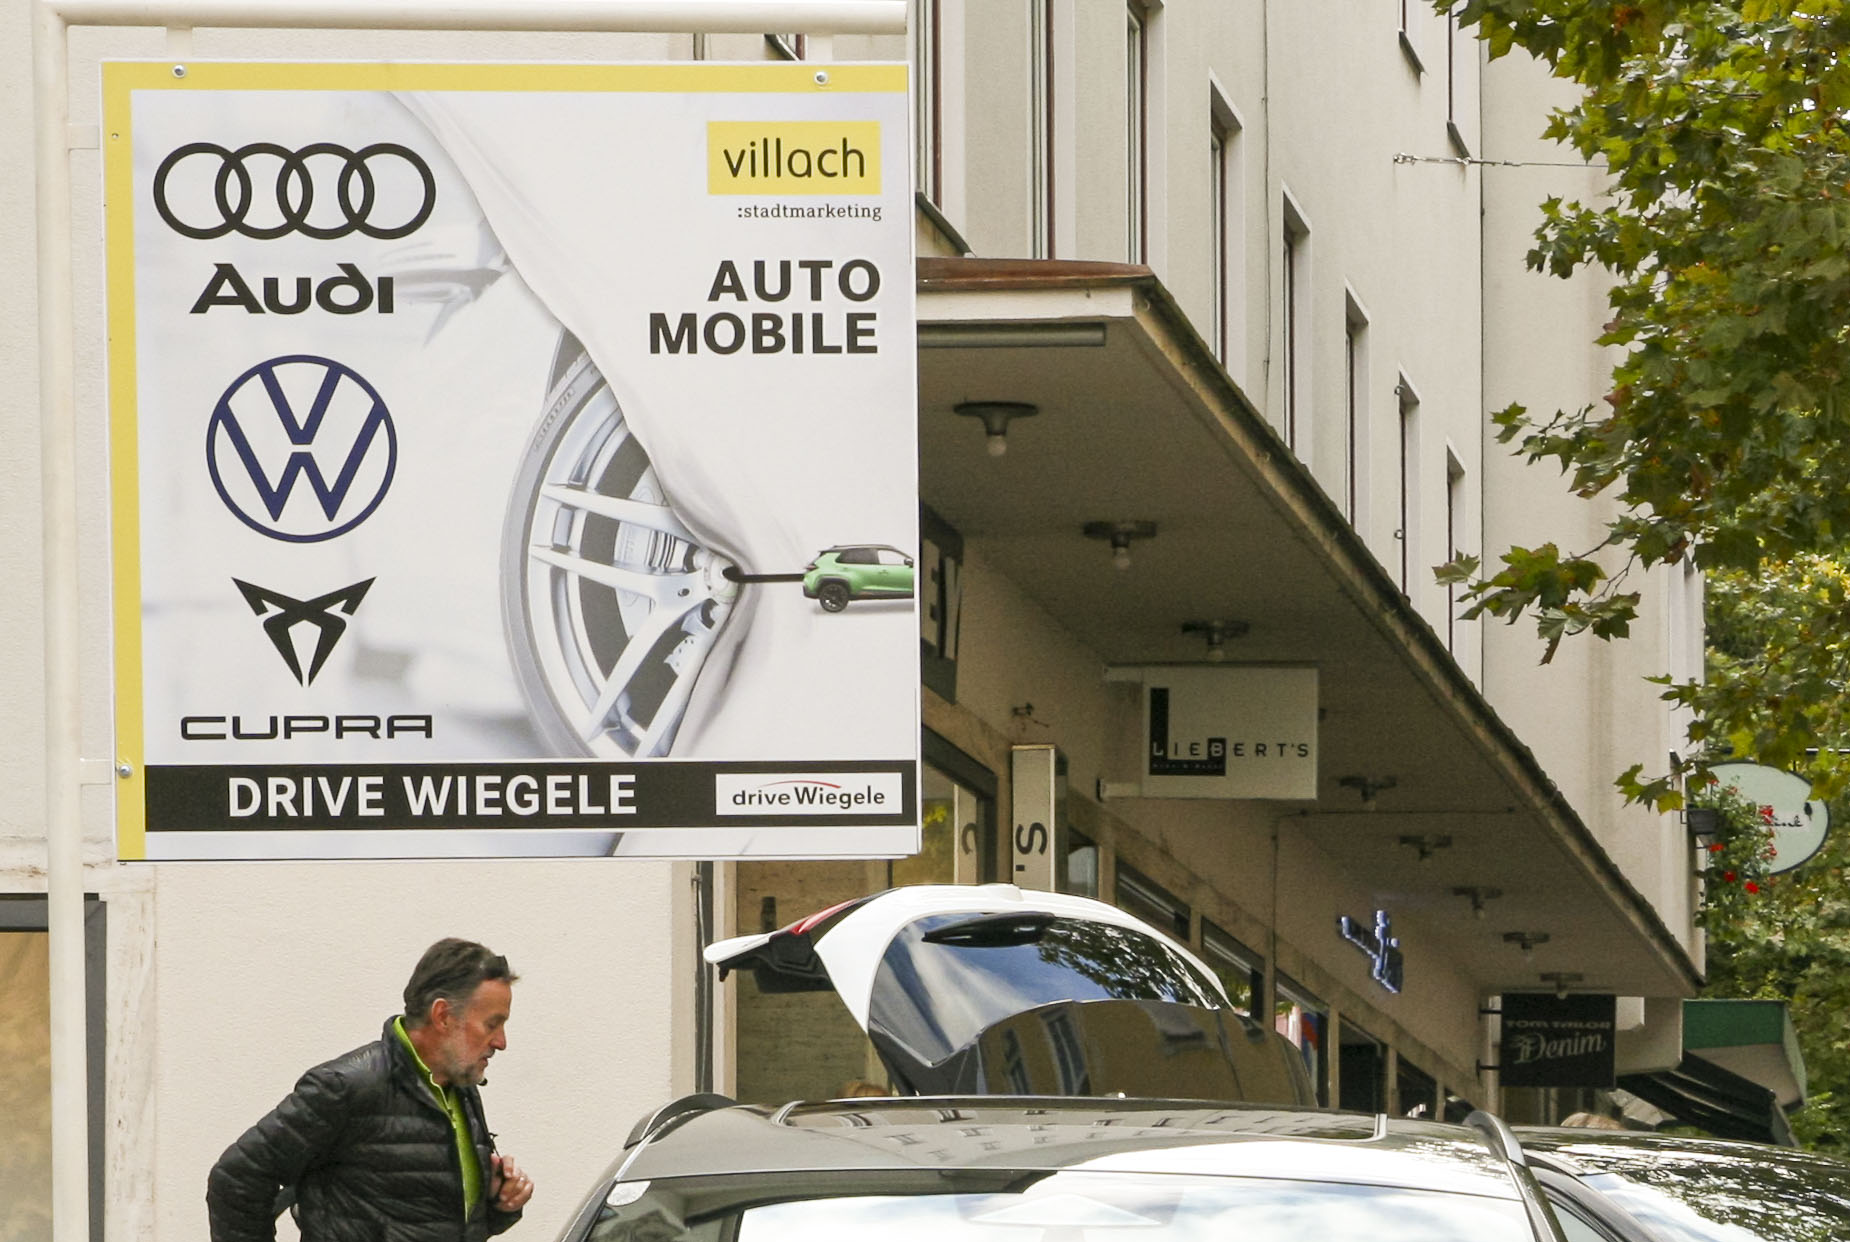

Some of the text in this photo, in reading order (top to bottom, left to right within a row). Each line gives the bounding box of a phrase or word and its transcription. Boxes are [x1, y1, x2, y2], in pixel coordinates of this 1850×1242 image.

[724, 138, 865, 179] villach
[190, 263, 394, 315] Audi
[708, 259, 881, 303] AUTO
[649, 312, 879, 355] MOBILE
[181, 715, 433, 741] CUPRA
[1152, 741, 1309, 758] LIEBERT'S
[228, 775, 637, 817] DRIVE WIEGELE
[1511, 1031, 1606, 1064] Denim
